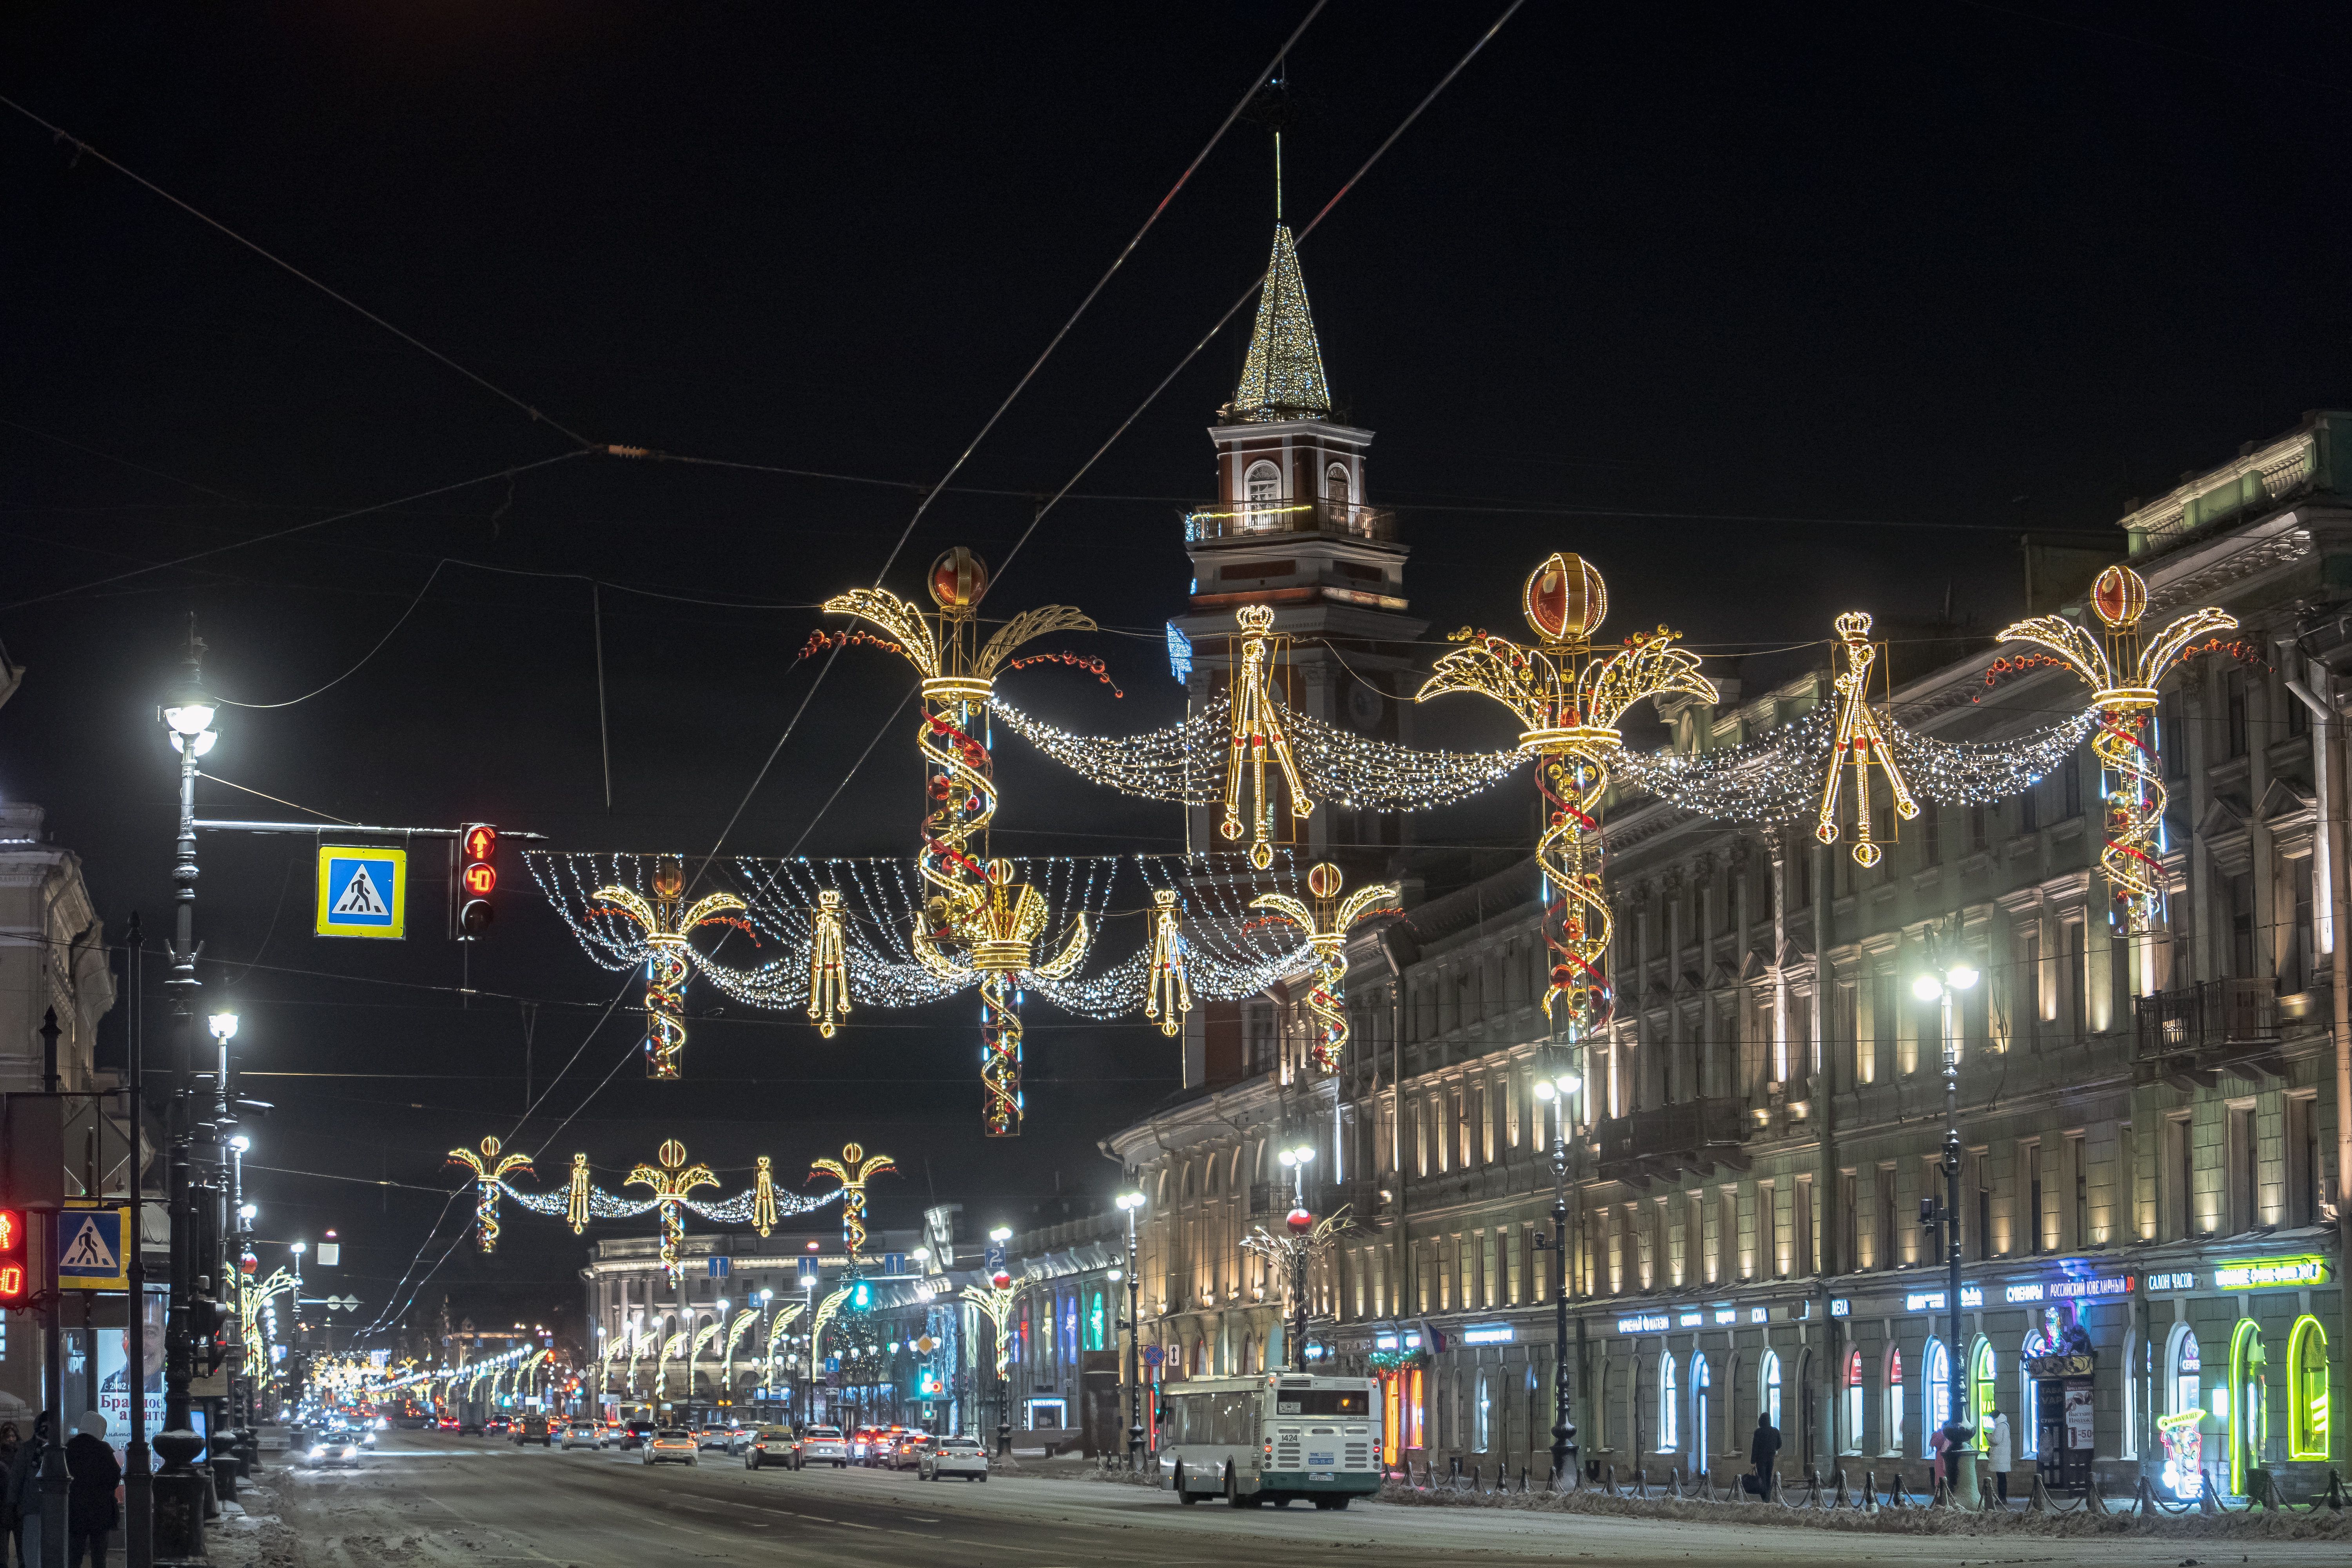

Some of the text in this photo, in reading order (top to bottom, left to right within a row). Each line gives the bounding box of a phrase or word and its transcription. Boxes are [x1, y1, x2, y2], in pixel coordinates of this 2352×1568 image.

[468, 869, 490, 891] 40
[2050, 1279, 2085, 1297] РОССИЙСКИЙ
[2086, 1275, 2125, 1294] ЮВЕЛИРНЫЙ
[2149, 1272, 2193, 1290] САЛОН ЧАСОВ
[2007, 1284, 2043, 1302] СУВЕНИРЫ
[1752, 1308, 1767, 1323] КОЖА
[1832, 1299, 1849, 1316] МЕХА
[1650, 1316, 1670, 1330] МАГАЗИН
